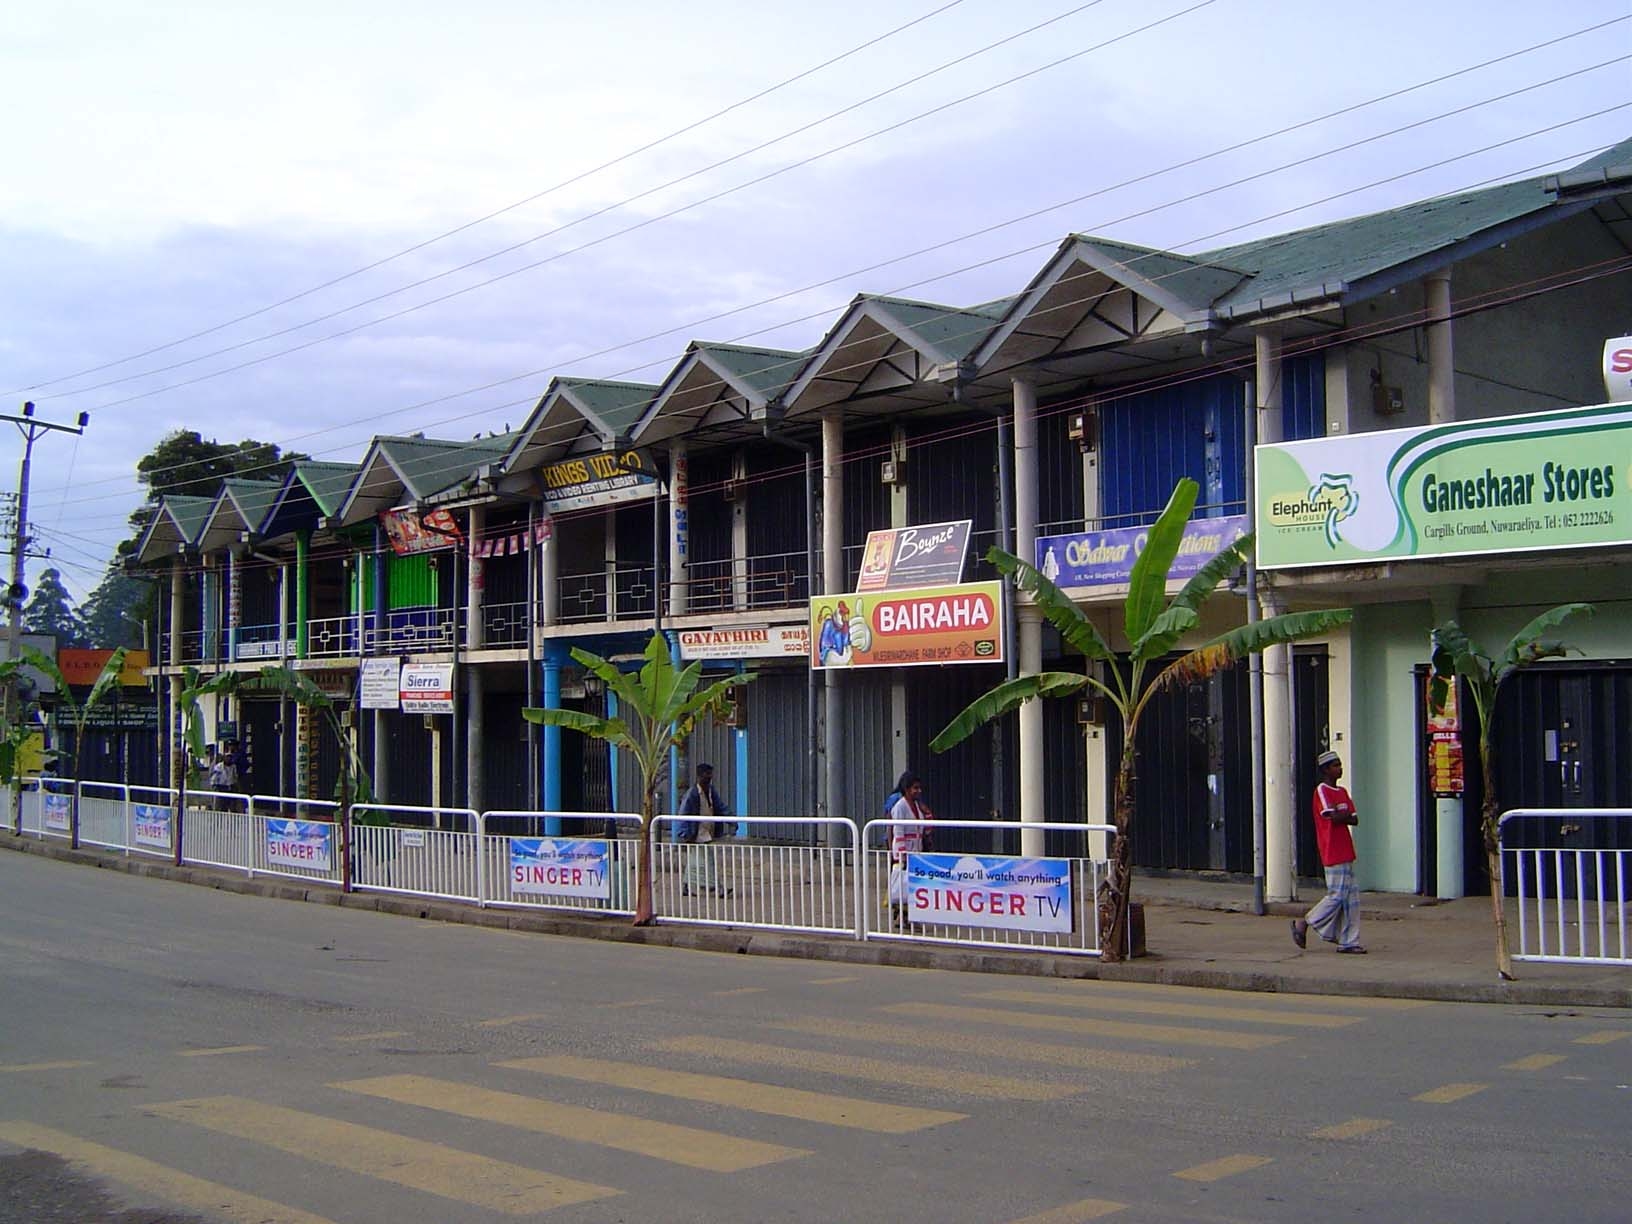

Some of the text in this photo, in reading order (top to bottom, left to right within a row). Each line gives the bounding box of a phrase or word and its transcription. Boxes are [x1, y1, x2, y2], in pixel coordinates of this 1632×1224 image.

[543, 461, 588, 488] KINGS
[1422, 461, 1614, 513] Ganeshaar Stores
[1272, 498, 1333, 522] Elephant HOUSE
[1424, 523, 1455, 540] Cargills
[1456, 520, 1489, 537] Ground,
[1544, 515, 1557, 528] Tel
[1563, 513, 1578, 527] 052
[894, 526, 954, 566] Bounze
[879, 598, 989, 632] BAIRAHA
[681, 629, 769, 645] GAYATHIRI
[407, 674, 440, 687] Sierra
[270, 841, 314, 860] SINGER
[515, 866, 604, 887] SINGER TV
[914, 867, 1062, 888] So good, you'll watch anything
[914, 887, 1062, 918] SINGER TV
